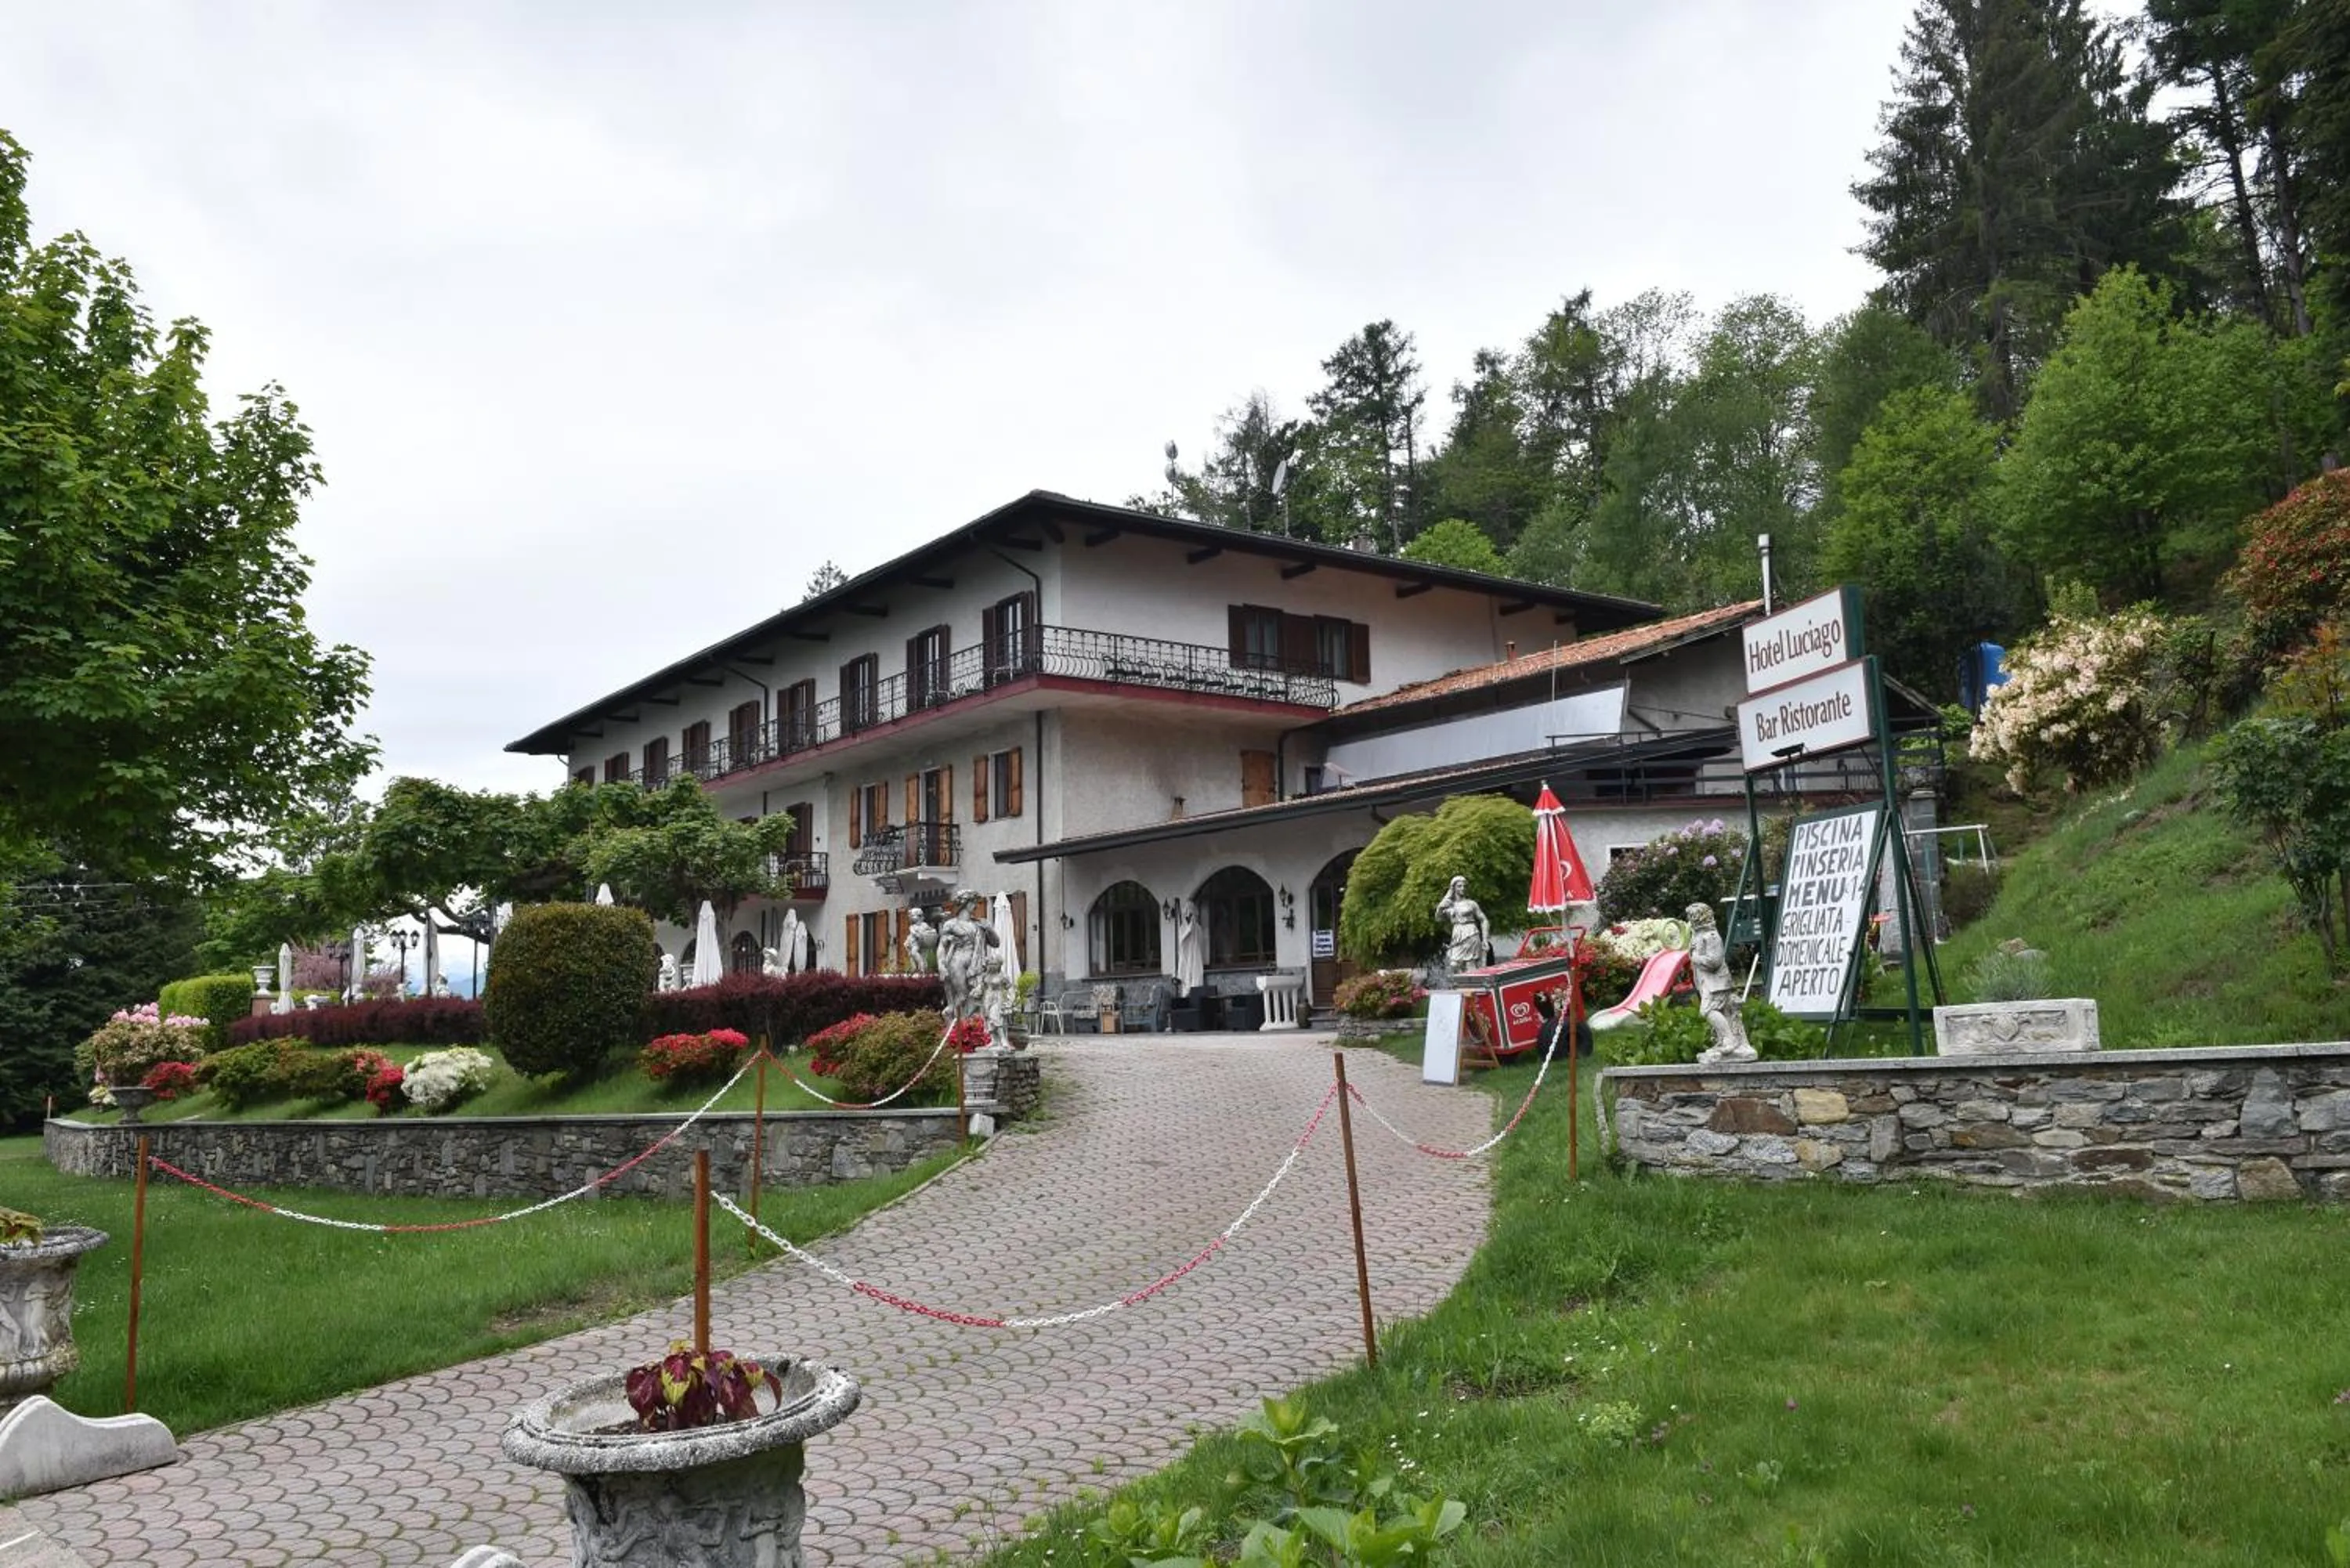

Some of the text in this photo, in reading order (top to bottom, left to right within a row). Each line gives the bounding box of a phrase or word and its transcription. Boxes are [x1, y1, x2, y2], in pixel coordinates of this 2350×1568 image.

[1748, 619, 1841, 673] Hotel Luciago
[1755, 691, 1852, 742] Bar Ristorante
[1796, 814, 1862, 850] PISCINA
[1791, 844, 1864, 880] PINSERIA
[1787, 876, 1846, 909] MENU
[1781, 906, 1843, 938] GRIGLIATA
[1775, 936, 1847, 967] DOMENICALE
[1777, 967, 1840, 996] APERTO
